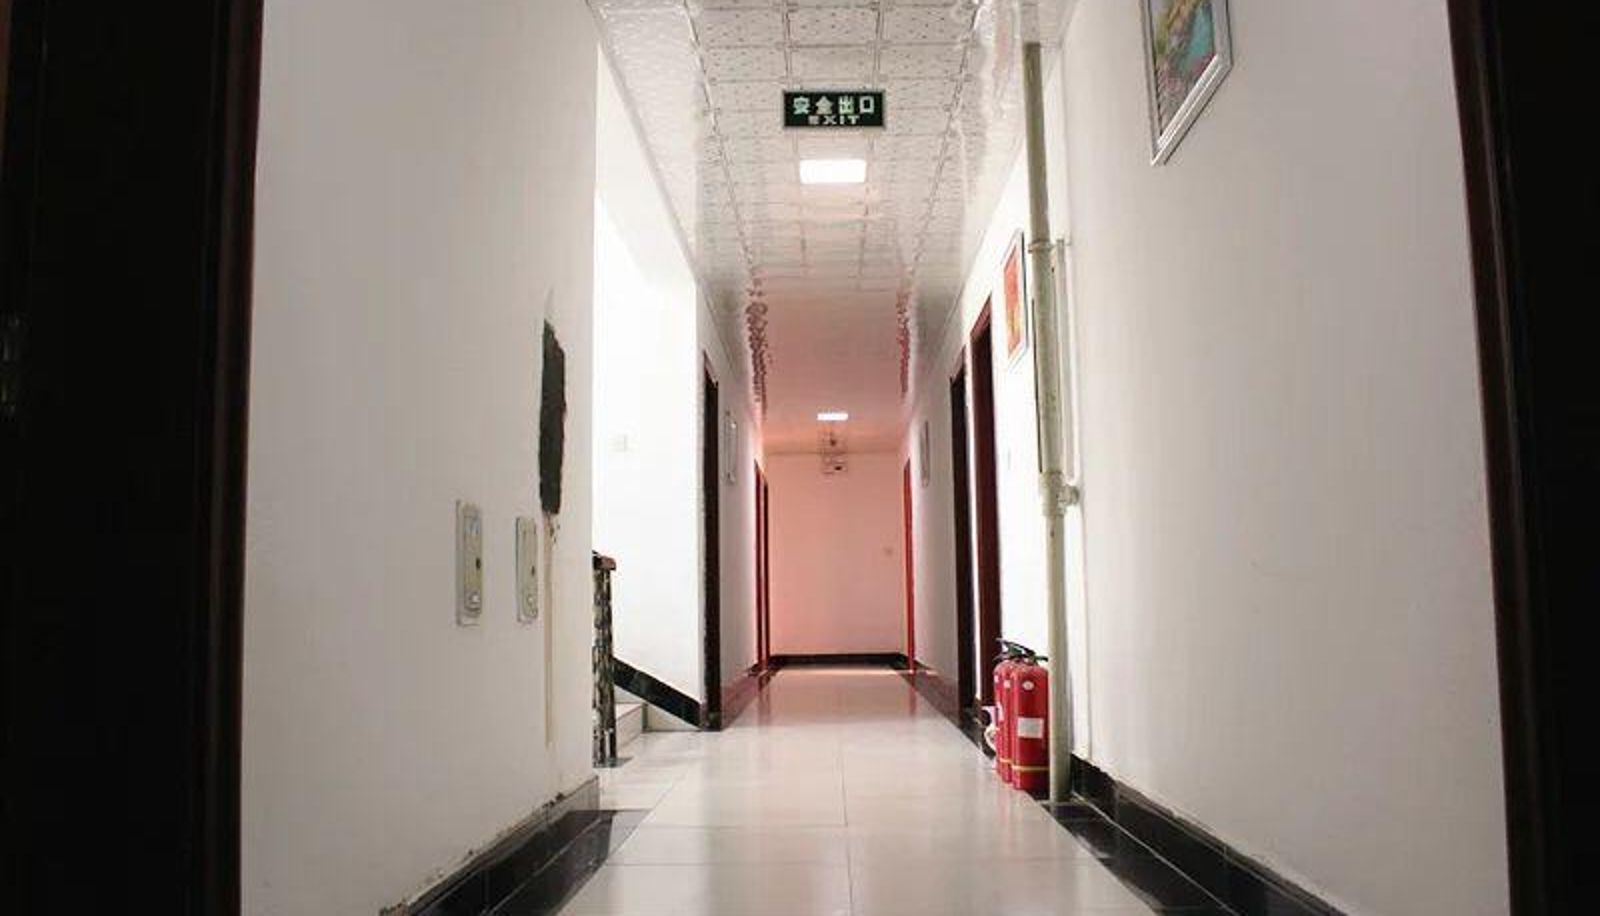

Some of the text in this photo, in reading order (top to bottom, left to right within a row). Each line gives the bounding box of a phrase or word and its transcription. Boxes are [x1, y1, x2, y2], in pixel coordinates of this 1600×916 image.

[793, 95, 875, 115] 安全出口
[808, 115, 860, 125] EXIT
